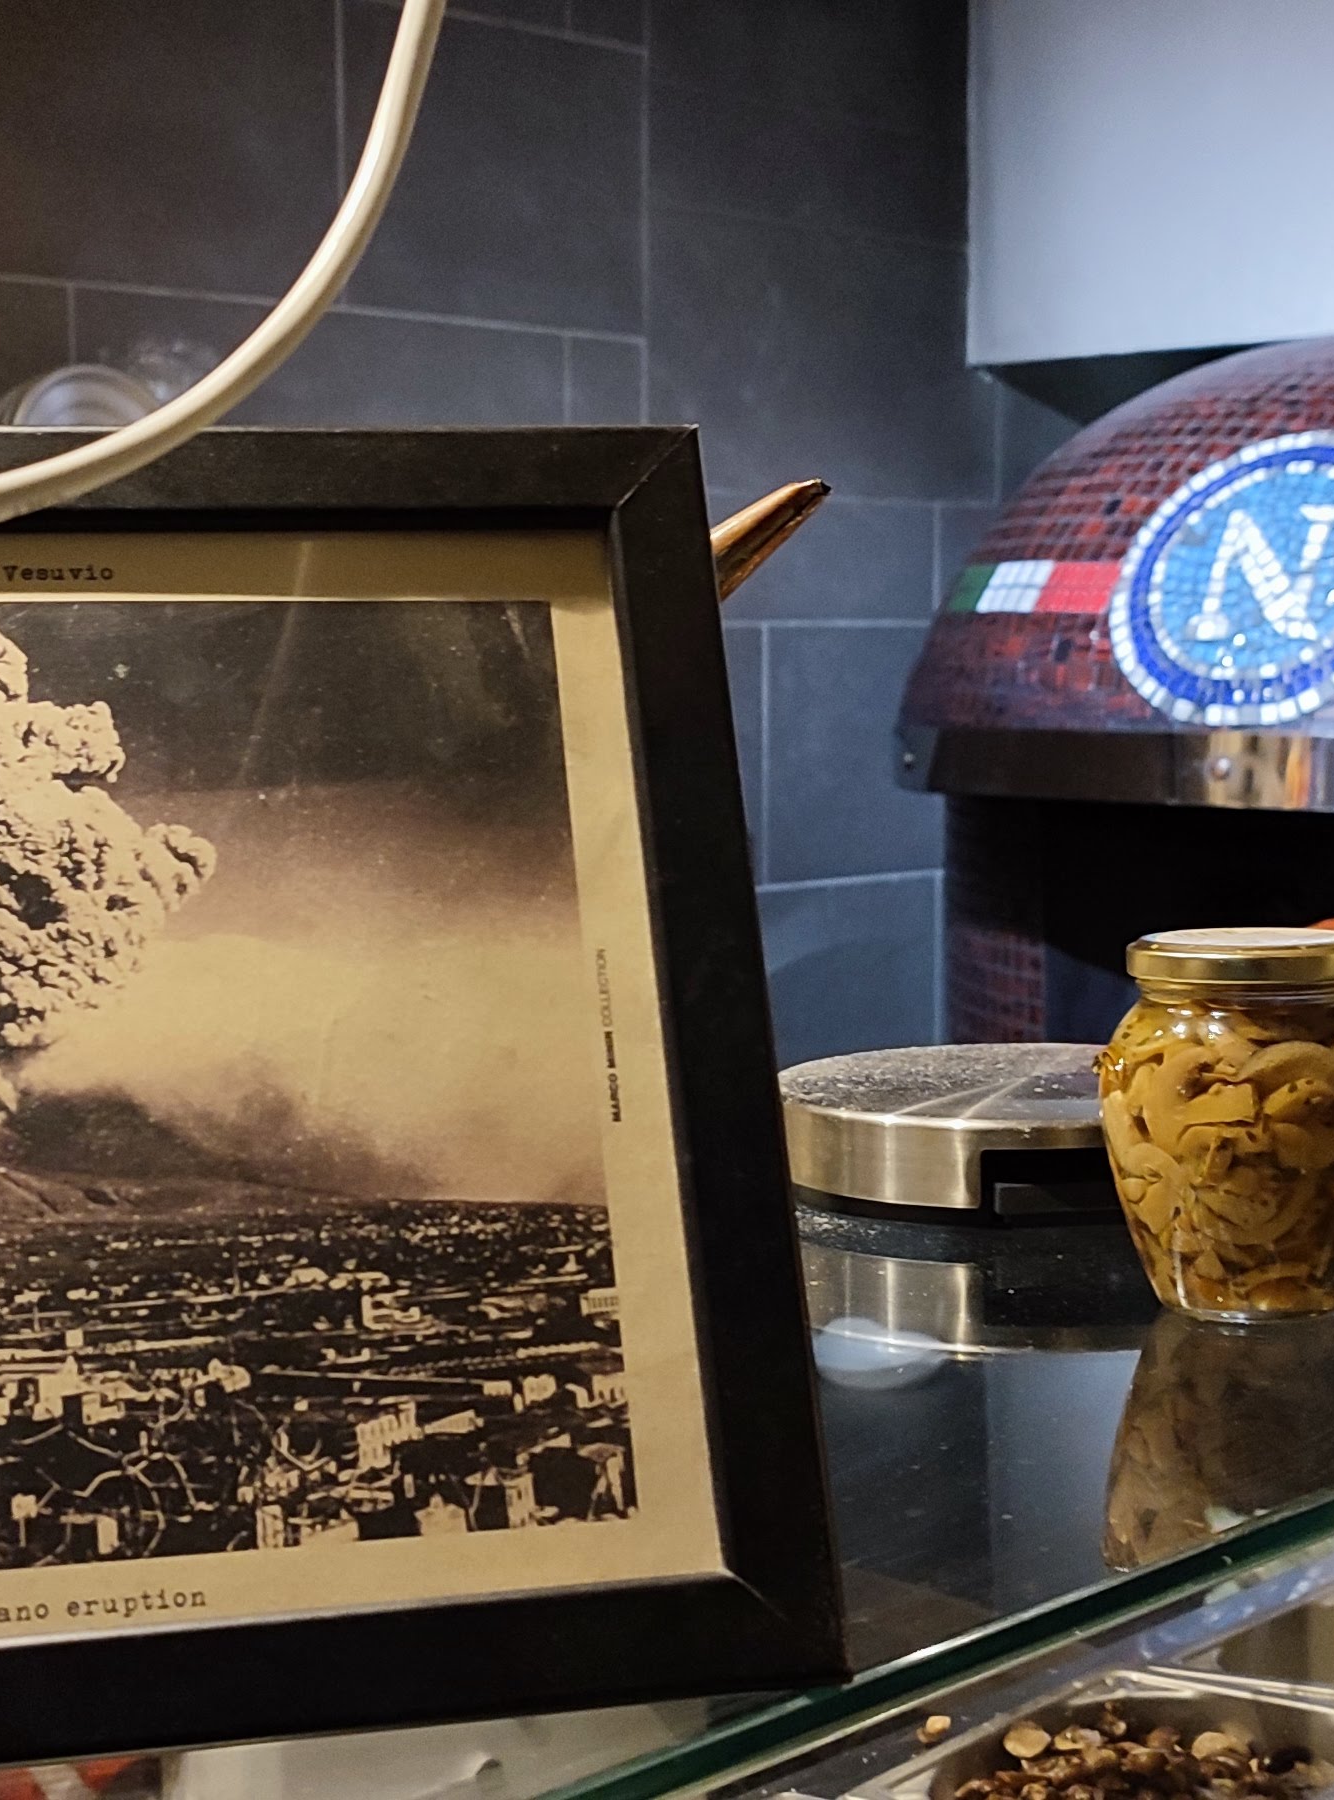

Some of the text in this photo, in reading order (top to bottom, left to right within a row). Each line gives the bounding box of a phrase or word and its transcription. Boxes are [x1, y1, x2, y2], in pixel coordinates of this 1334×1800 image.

[2, 564, 115, 582] Vesuvio
[596, 949, 613, 1027] COLLECTION
[66, 1588, 207, 1618] eruption
